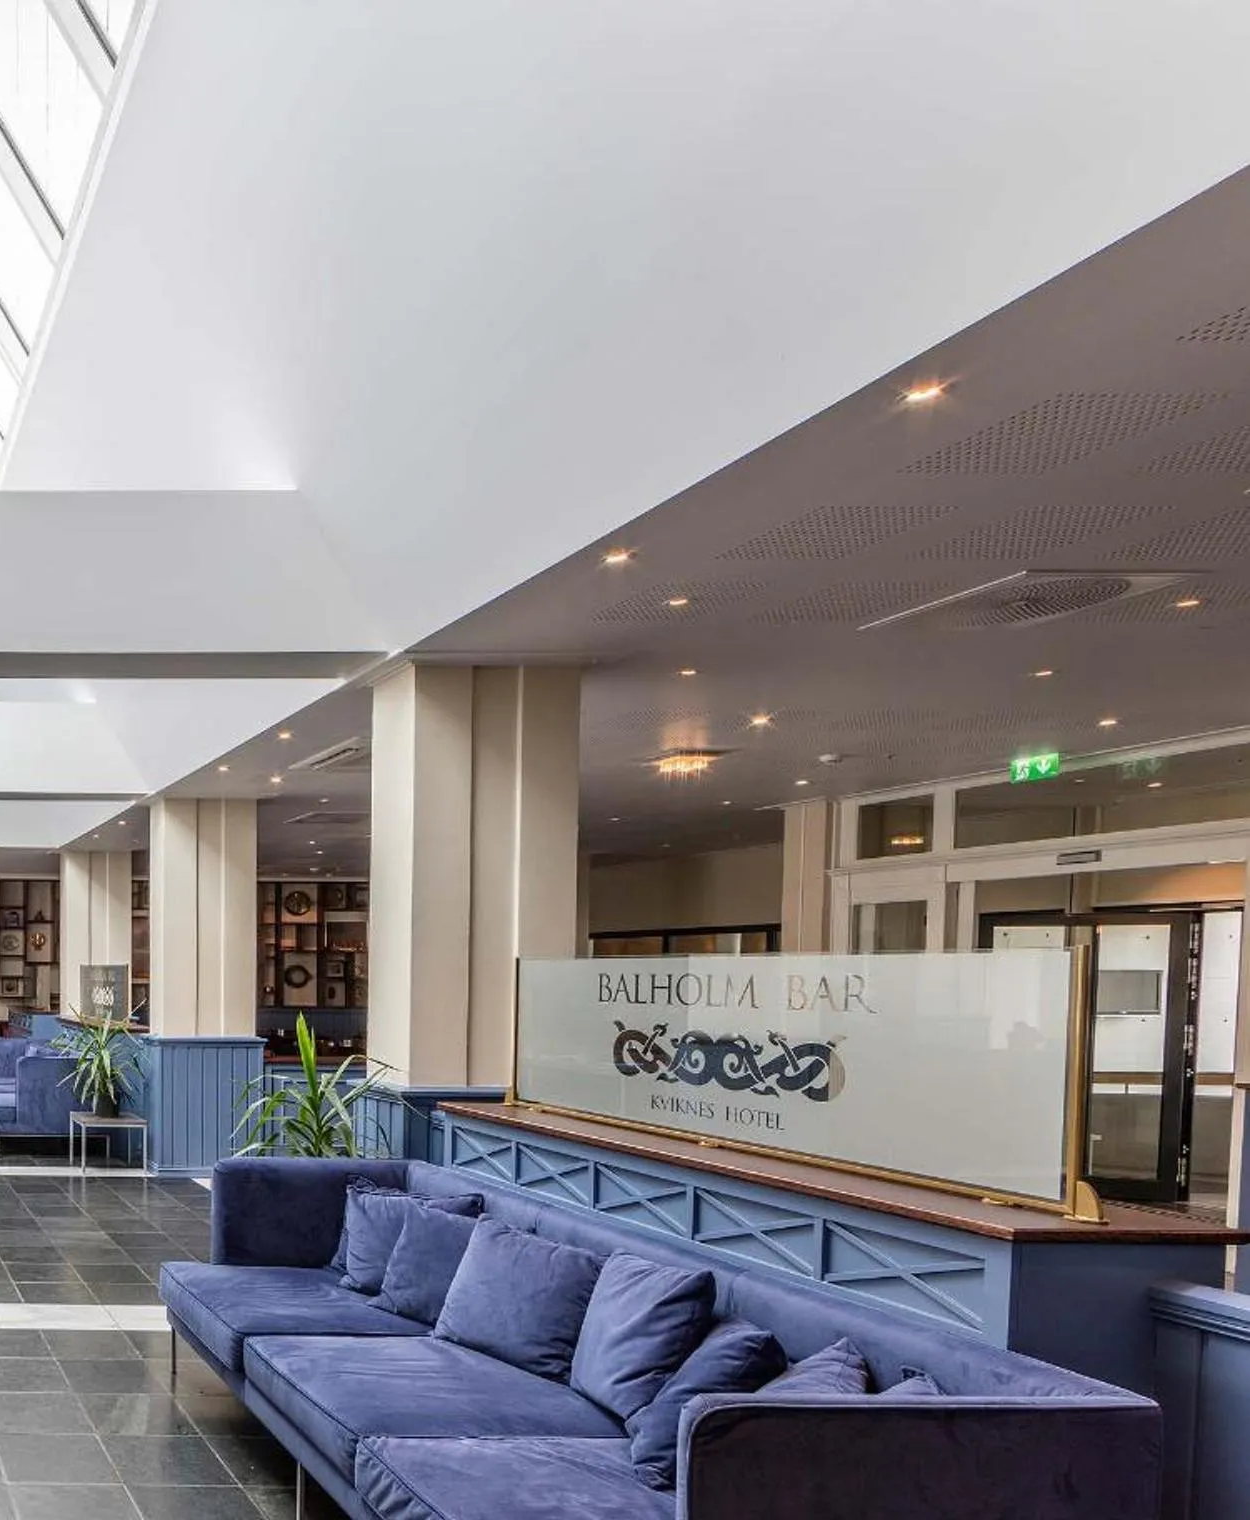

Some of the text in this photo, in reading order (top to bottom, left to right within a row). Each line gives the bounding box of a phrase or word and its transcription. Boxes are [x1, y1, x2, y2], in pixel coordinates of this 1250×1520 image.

[598, 972, 878, 1015] BALHOLM BAR
[650, 1094, 786, 1131] KVIKNES HOTEL
